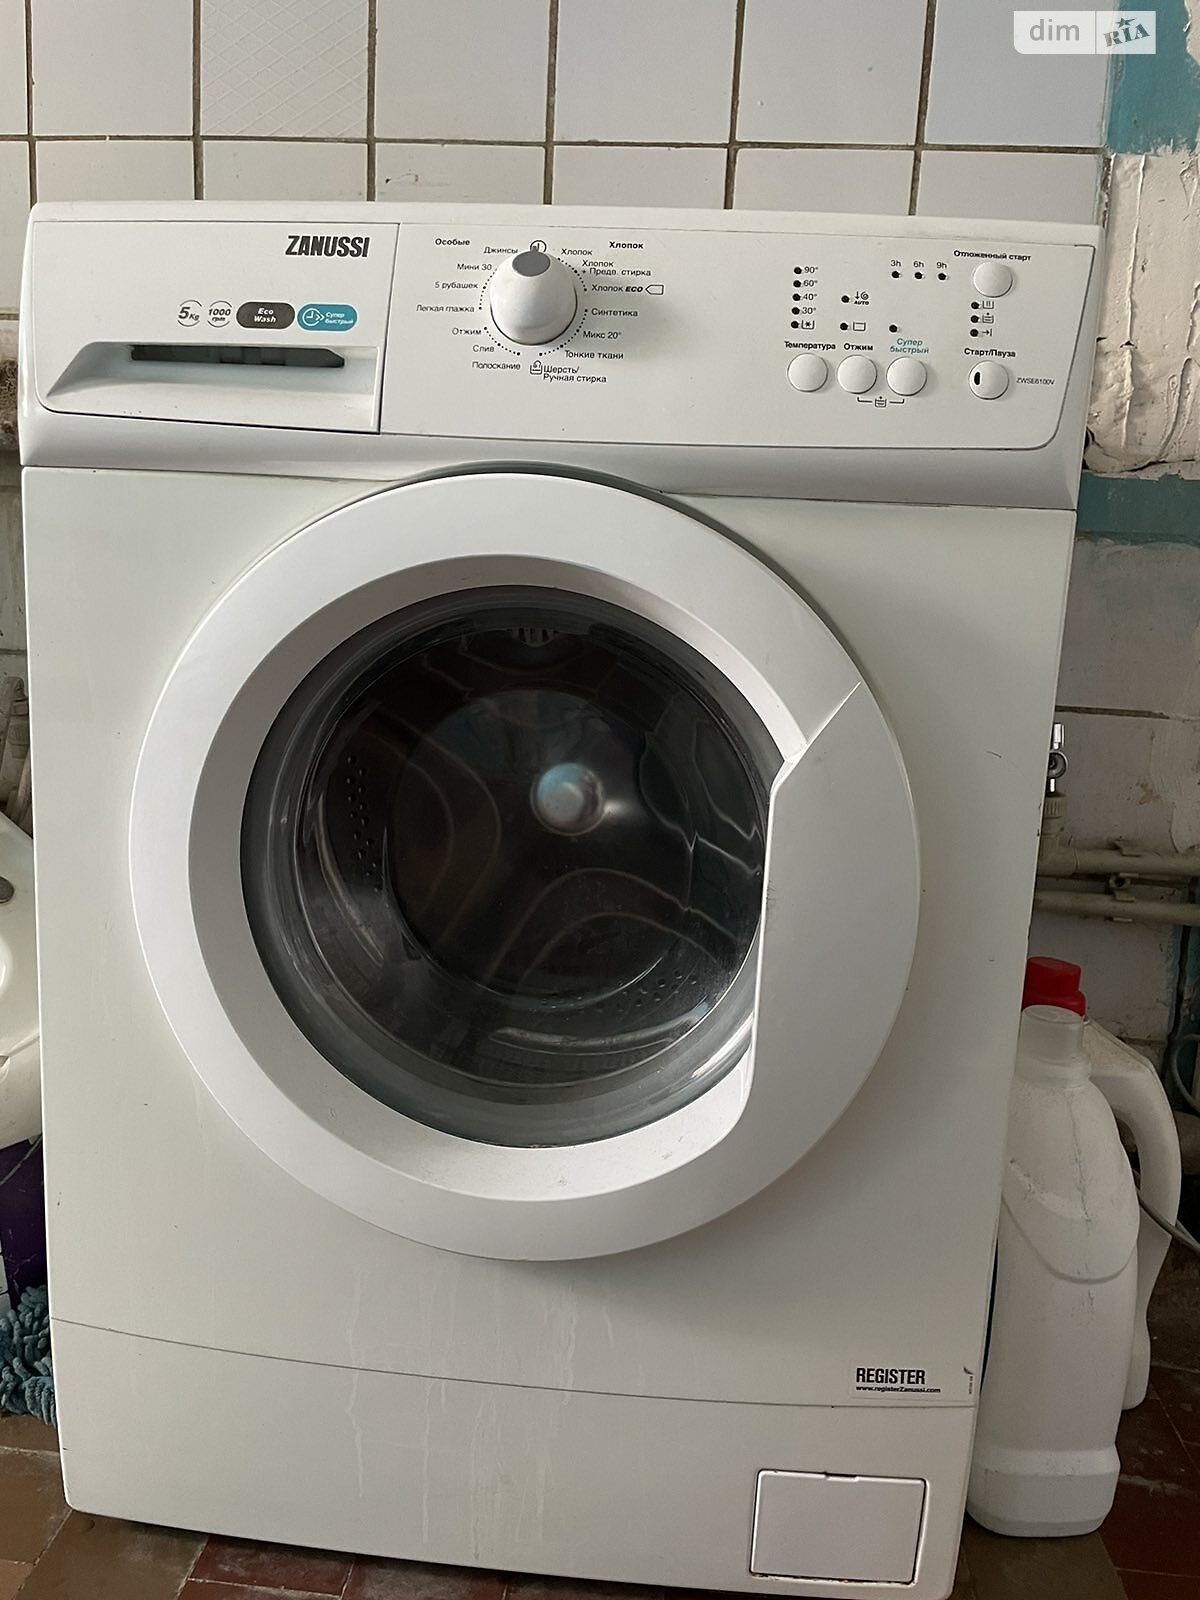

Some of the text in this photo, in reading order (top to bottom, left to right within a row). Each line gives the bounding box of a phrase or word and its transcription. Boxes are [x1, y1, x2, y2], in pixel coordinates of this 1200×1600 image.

[285, 235, 371, 258] ZANUSSI
[435, 238, 471, 246] Особые
[609, 241, 644, 249] Хлопок
[483, 246, 518, 254] Джинсы
[561, 248, 593, 256] Хлопок
[953, 249, 1032, 262] Отложенный старт
[481, 263, 493, 271] 30
[582, 259, 614, 267] Хлопок
[890, 259, 902, 267] 3h
[913, 260, 925, 268] 6h
[936, 261, 948, 269] 9h
[803, 265, 819, 274] 90°
[434, 281, 479, 290] 5 рубашек
[591, 283, 624, 292] Хлопок
[803, 279, 818, 287] 60°
[802, 293, 818, 301] 40°
[208, 308, 231, 317] 1000
[257, 307, 275, 315] Eco
[416, 304, 475, 313] Легкая глажка
[591, 308, 639, 317] Синтетика
[801, 306, 817, 315] 30°
[253, 315, 277, 324] Wash
[325, 311, 345, 319] Супер
[452, 327, 482, 335] Отжим
[582, 331, 622, 340] Микс 20°
[784, 341, 836, 351] Температура
[843, 342, 874, 352] Отжим
[896, 338, 923, 347] Супер
[472, 344, 495, 353] Слив
[889, 346, 930, 355] быстрый
[964, 347, 1016, 358] Старт/Пауза
[564, 349, 624, 360] Тонкие ткани
[472, 361, 521, 370] Полоскание
[543, 365, 580, 374] Шерсть/
[543, 373, 607, 383] Ручная стирка
[856, 1367, 926, 1385] REGISTER
[855, 1386, 941, 1394] www.registerZanussi.com
